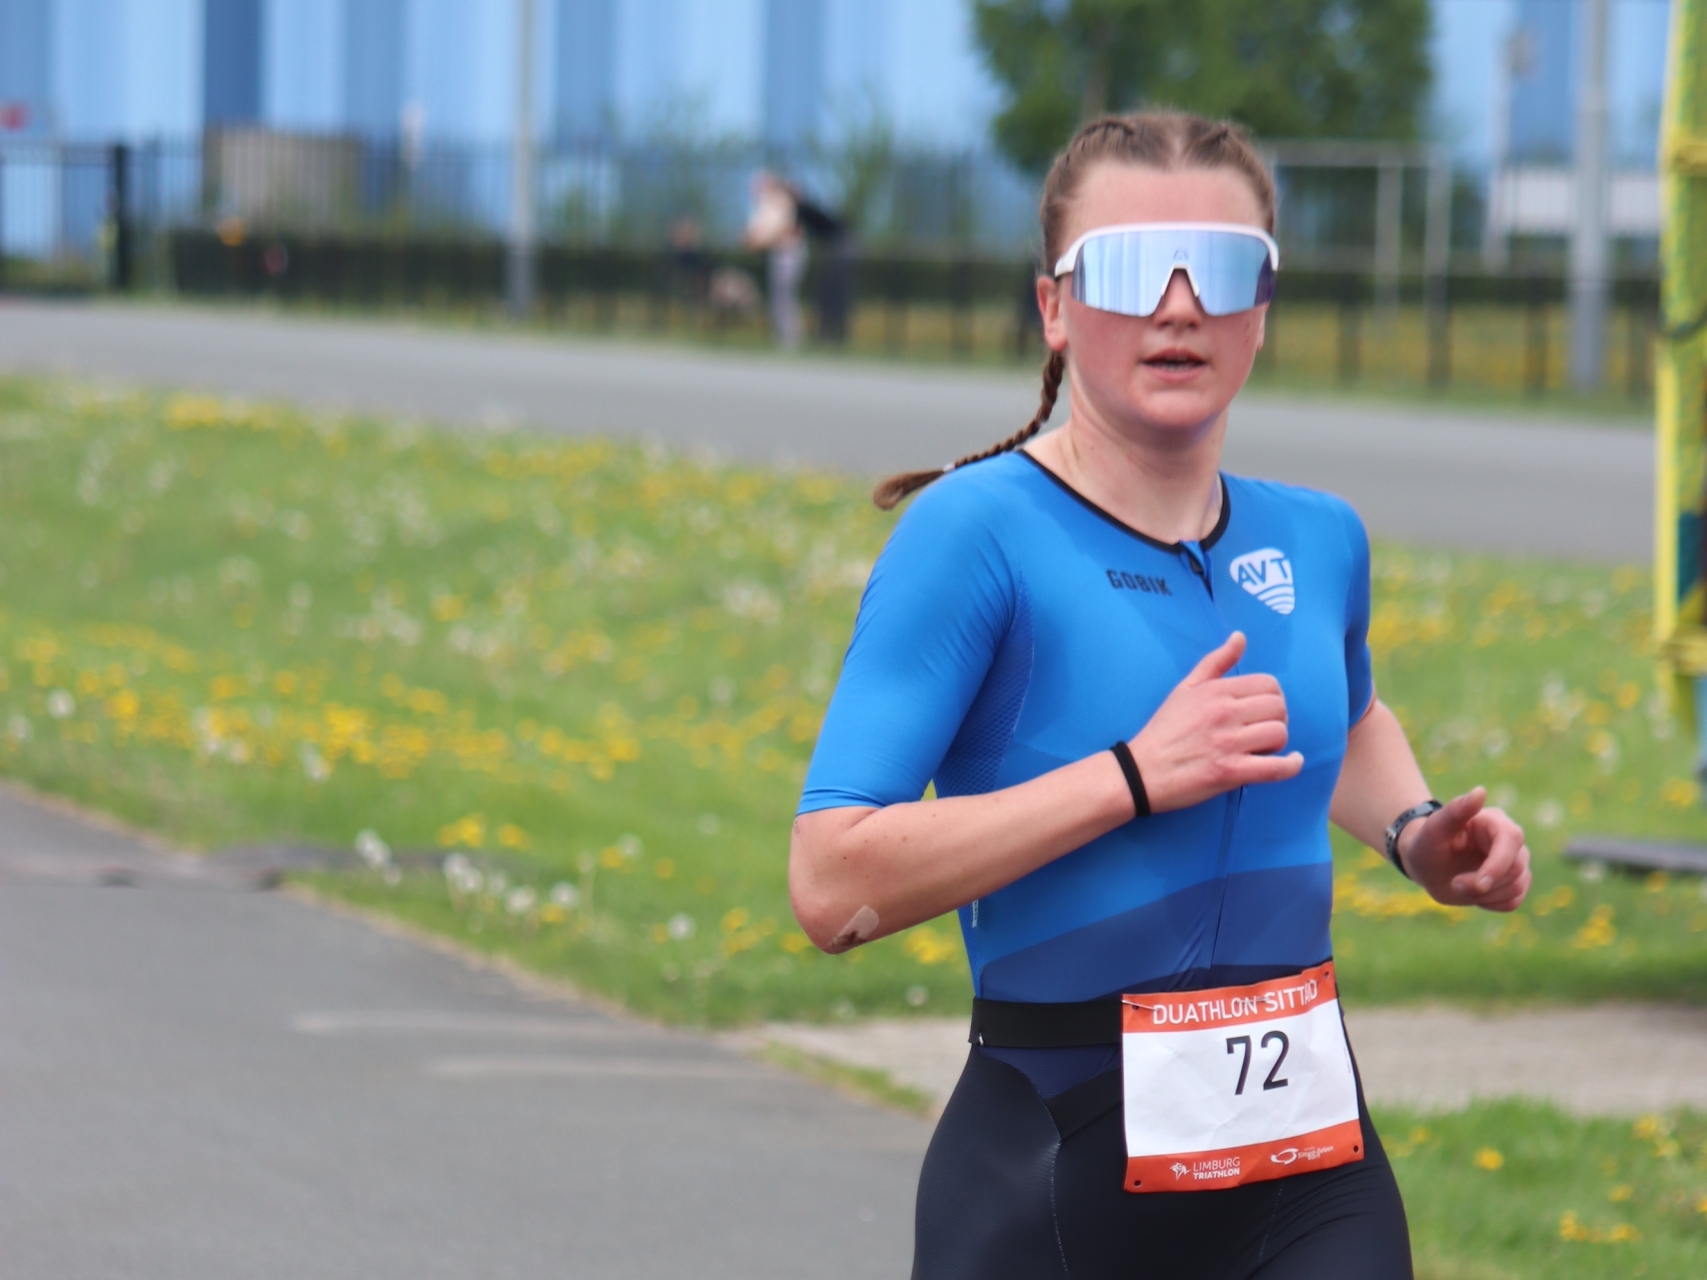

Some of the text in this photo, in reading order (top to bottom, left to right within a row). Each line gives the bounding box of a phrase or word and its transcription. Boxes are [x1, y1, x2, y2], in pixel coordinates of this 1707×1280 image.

[1106, 569, 1173, 597] GOBIK
[1237, 557, 1291, 586] AVT
[1153, 997, 1258, 1025] DUATHLON
[1226, 1030, 1290, 1096] 72
[1193, 1157, 1241, 1172] LIMBURG
[1193, 1168, 1240, 1181] TRIATHLON
